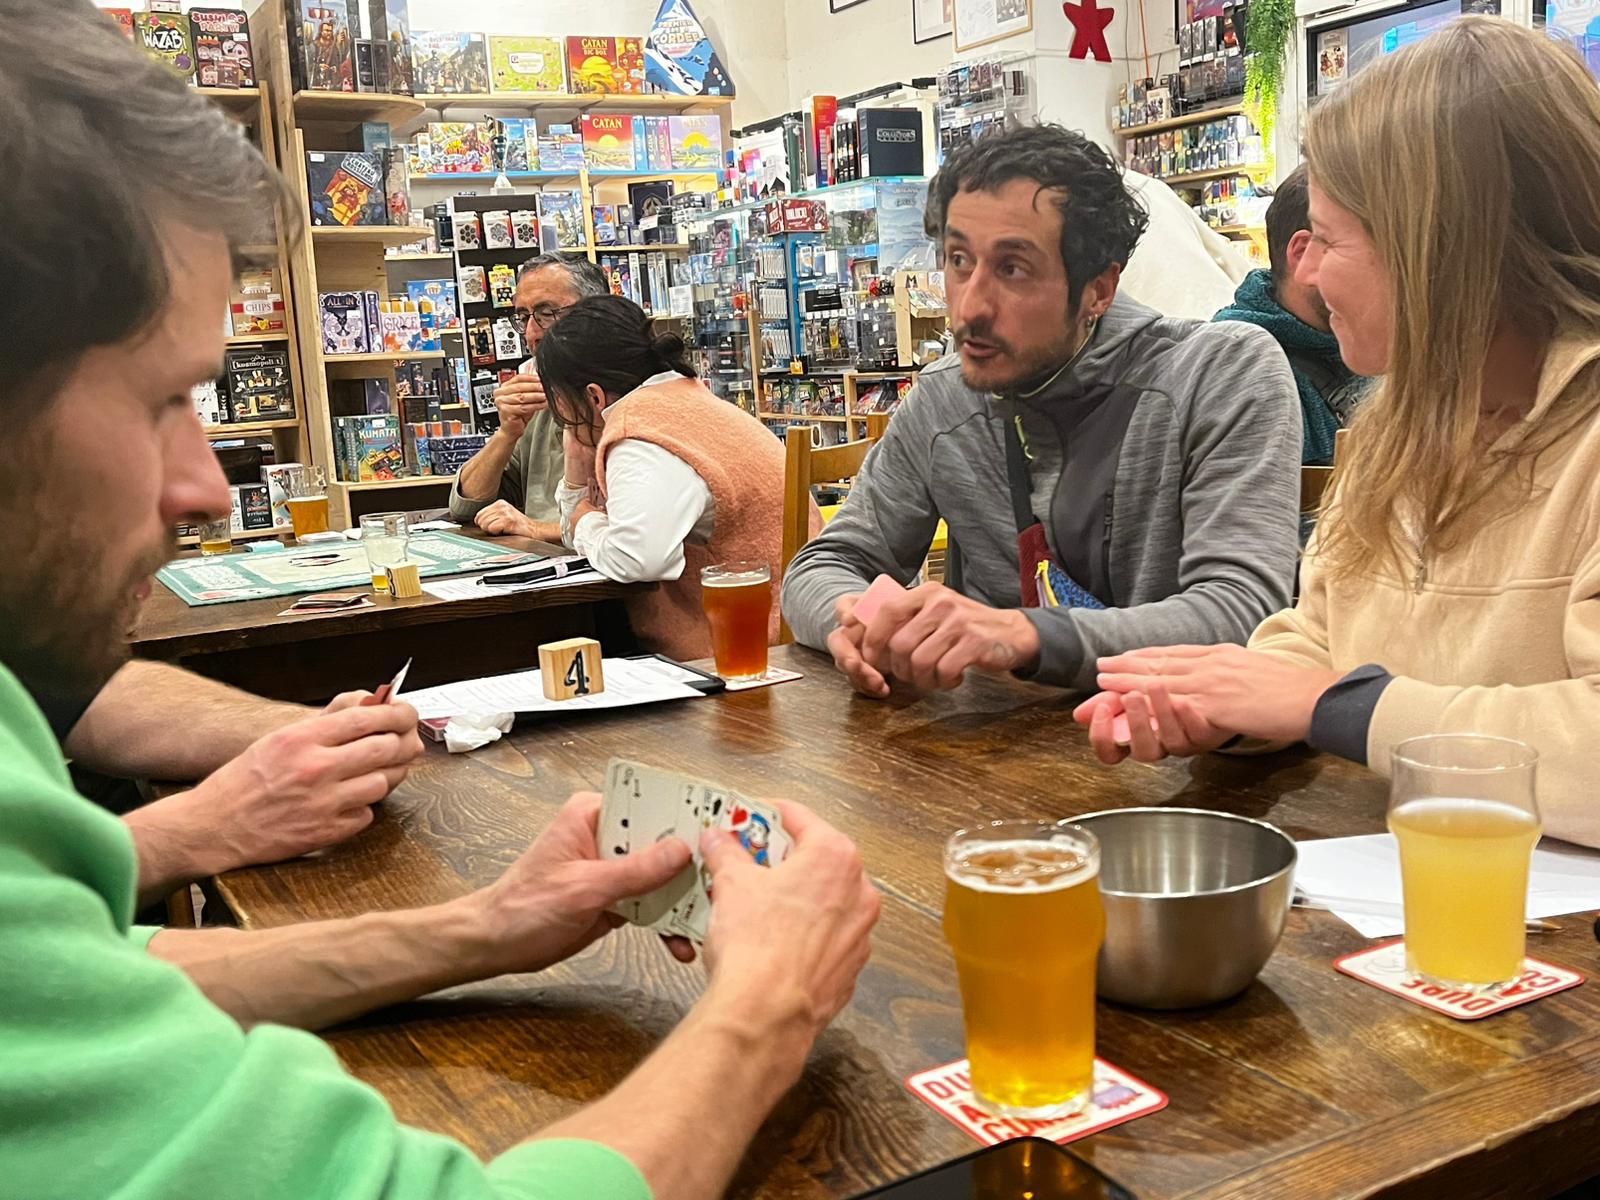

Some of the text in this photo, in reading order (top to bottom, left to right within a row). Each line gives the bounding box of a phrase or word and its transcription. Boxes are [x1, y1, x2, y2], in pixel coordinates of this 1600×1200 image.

[582, 38, 608, 48] CATAN
[592, 117, 623, 129] CATAN
[245, 303, 272, 312] CHIPS
[564, 649, 590, 696] 4
